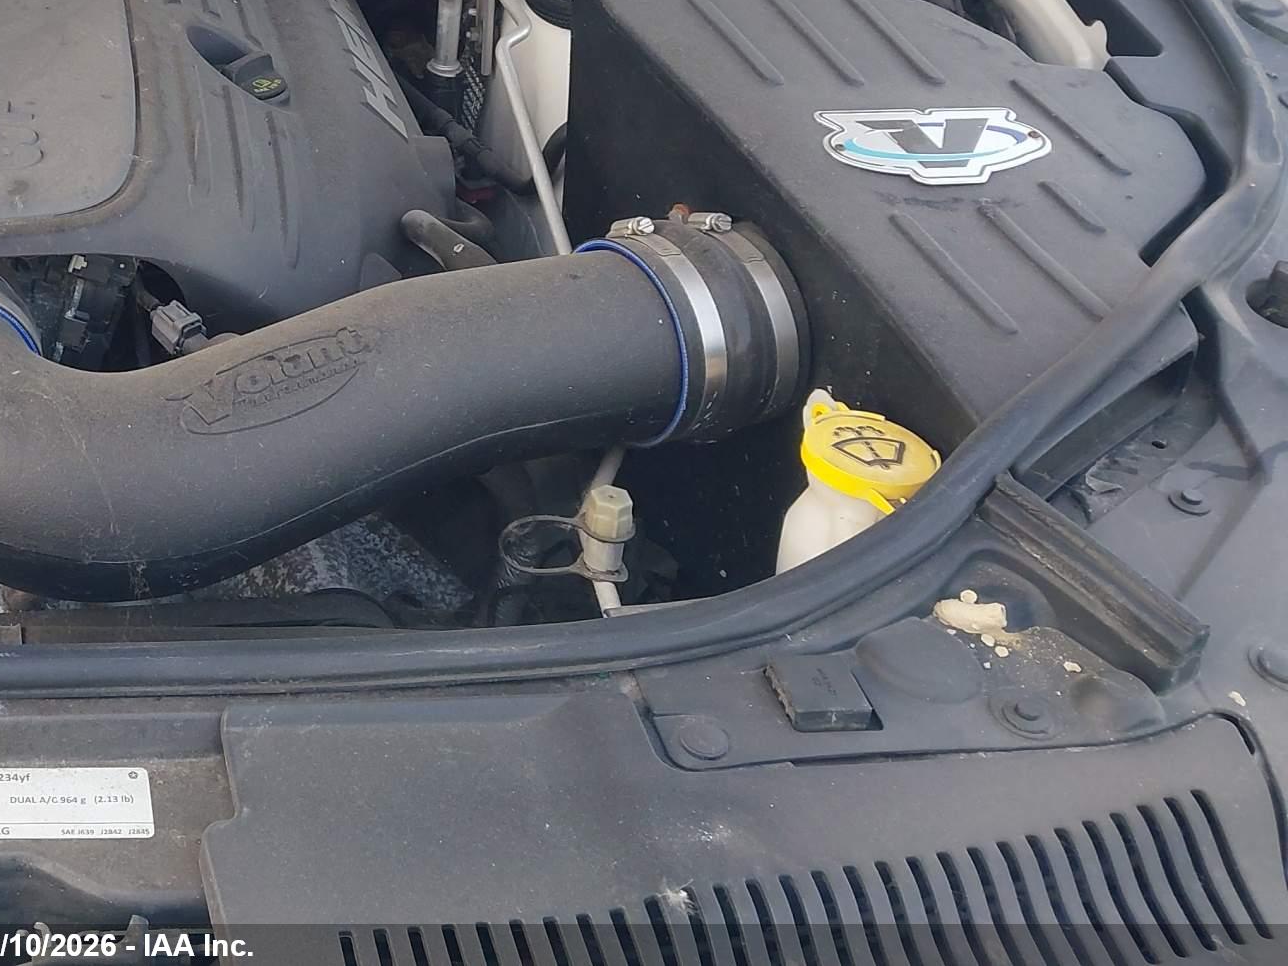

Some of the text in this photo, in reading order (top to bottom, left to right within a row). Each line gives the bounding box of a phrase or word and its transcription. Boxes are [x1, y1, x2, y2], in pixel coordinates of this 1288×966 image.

[9, 794, 134, 805] DUAL A/C 964 g (2.13 lb)
